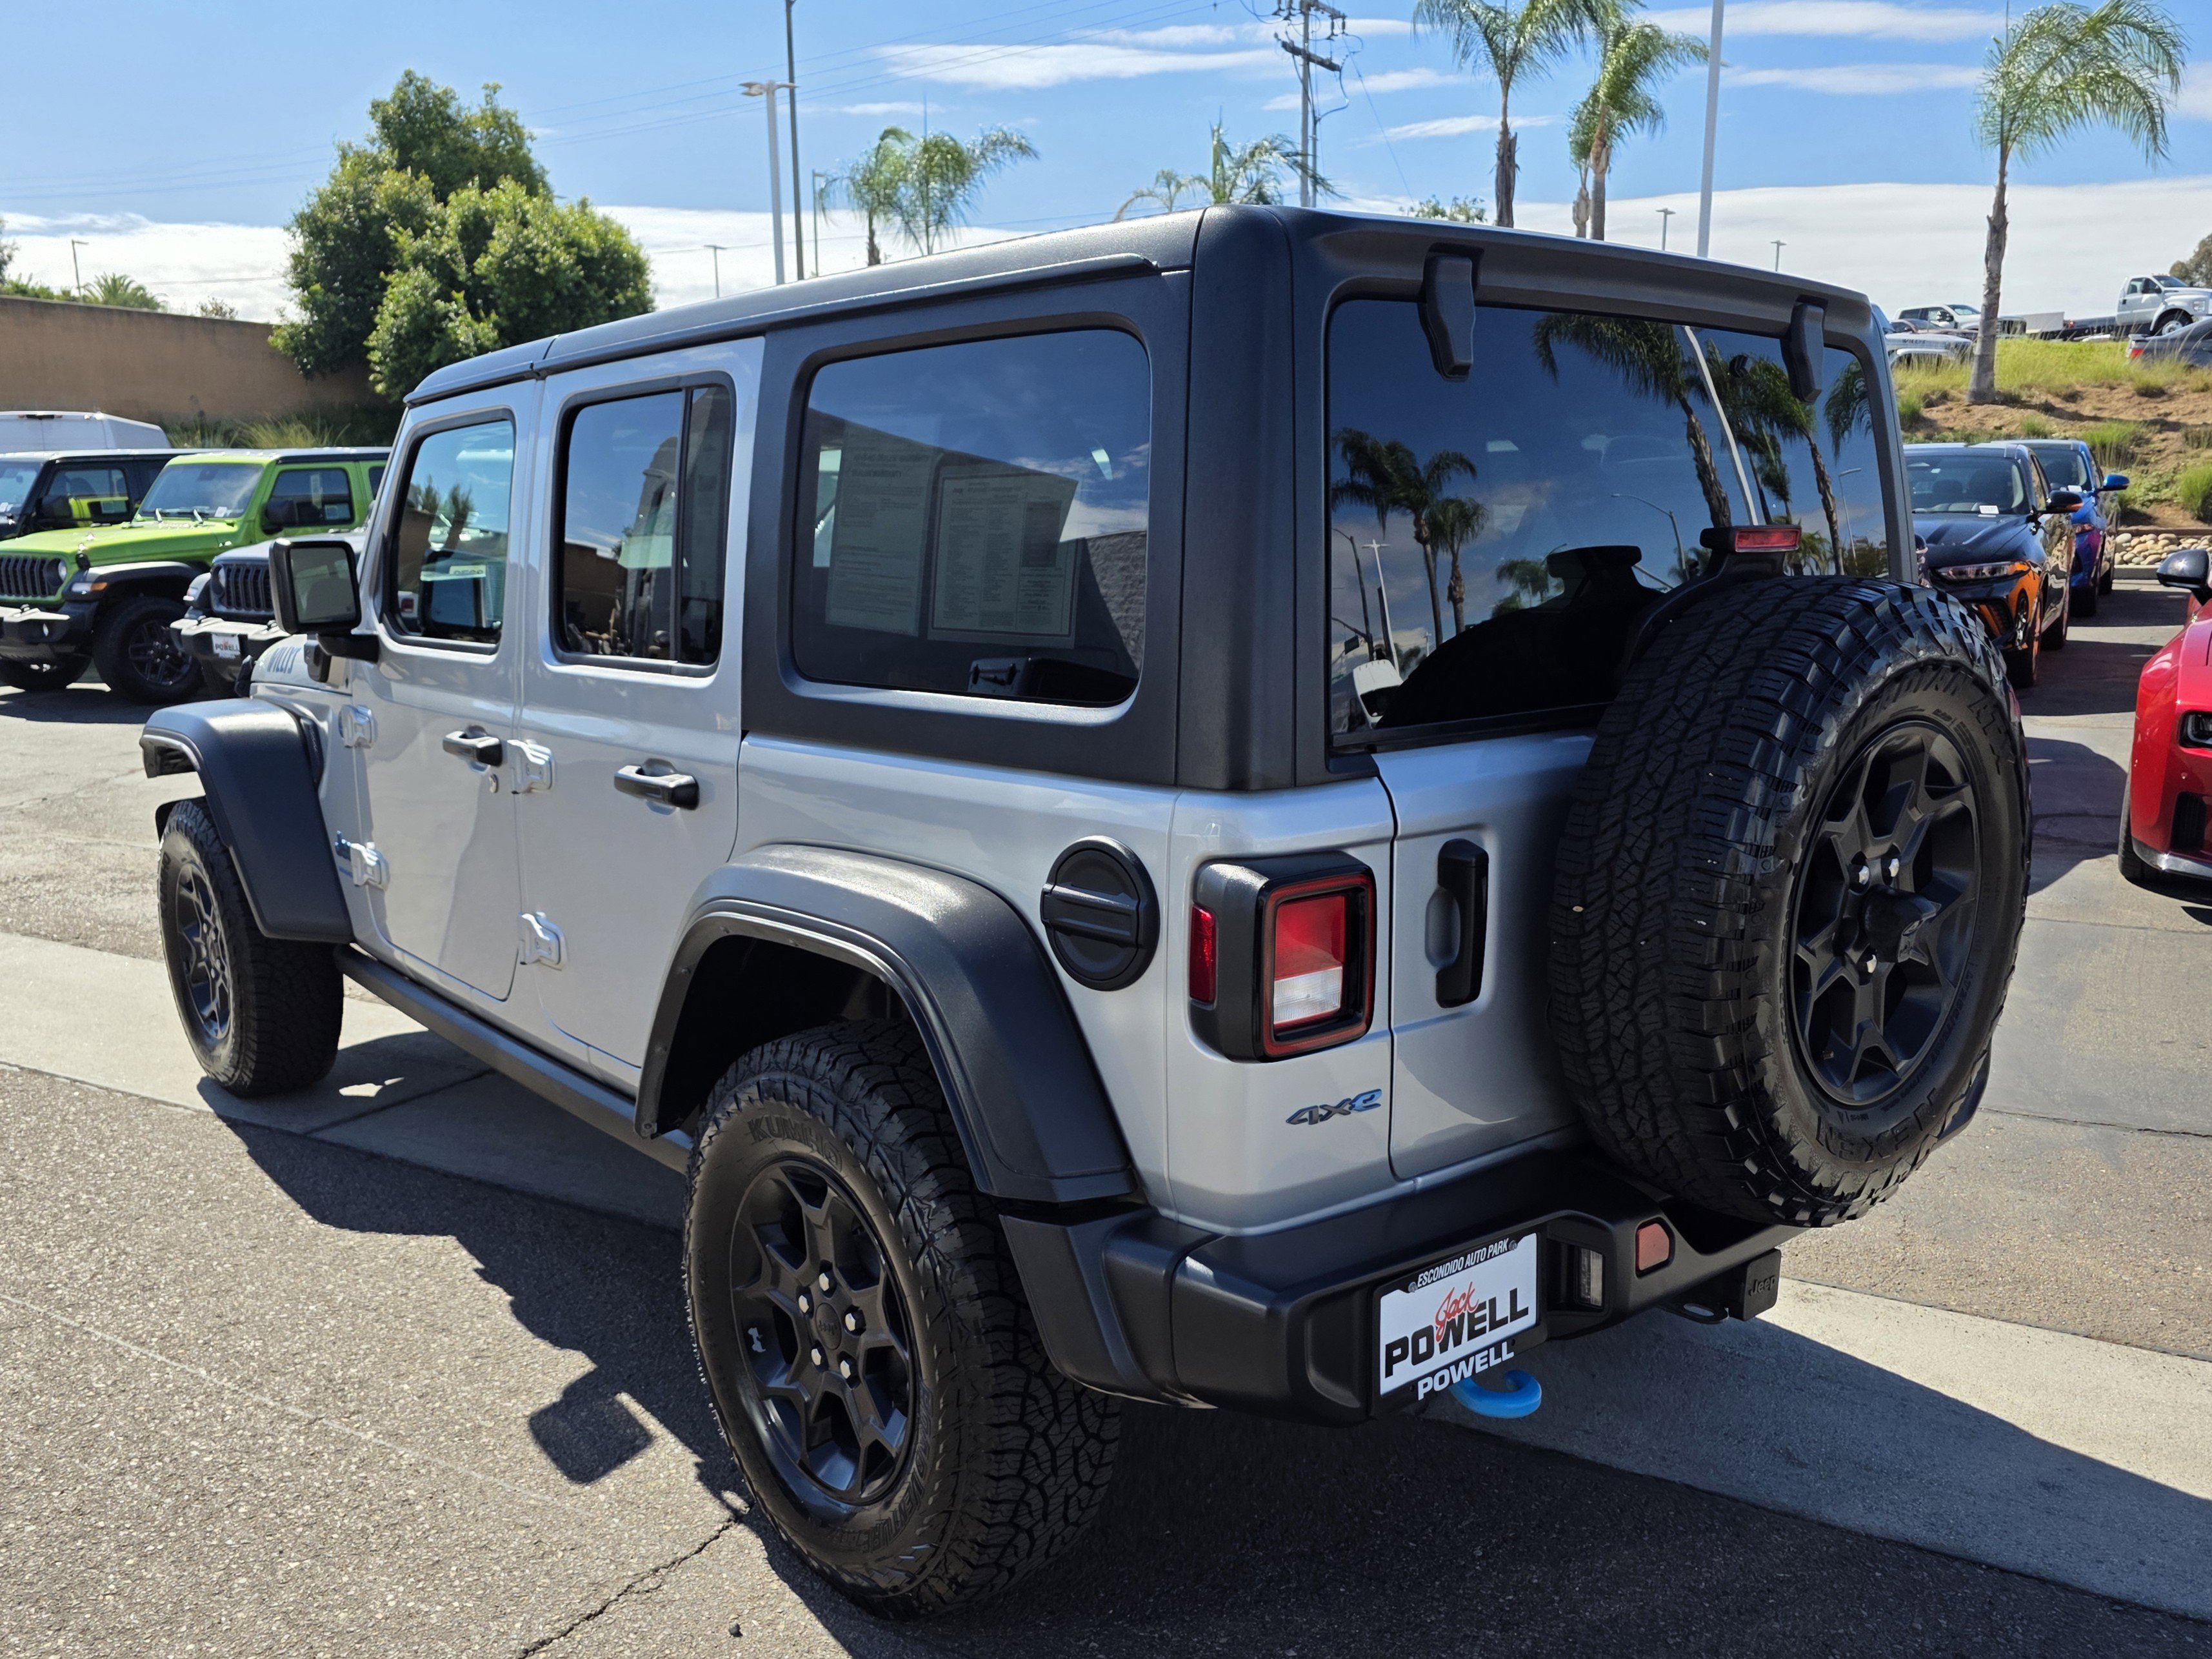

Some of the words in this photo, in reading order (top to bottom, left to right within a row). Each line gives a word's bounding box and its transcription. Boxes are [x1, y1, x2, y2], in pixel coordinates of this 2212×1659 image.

[746, 1114, 843, 1173] KUMHO
[1417, 1256, 1465, 1288] ESCONDIDO
[1464, 1247, 1487, 1267] AUTO
[1488, 1238, 1510, 1259] PARK
[1748, 1275, 1775, 1296] Jeep
[1385, 1287, 1529, 1379] POWELL
[1435, 1281, 1479, 1342] Jack
[1418, 1340, 1515, 1401] POWELL
